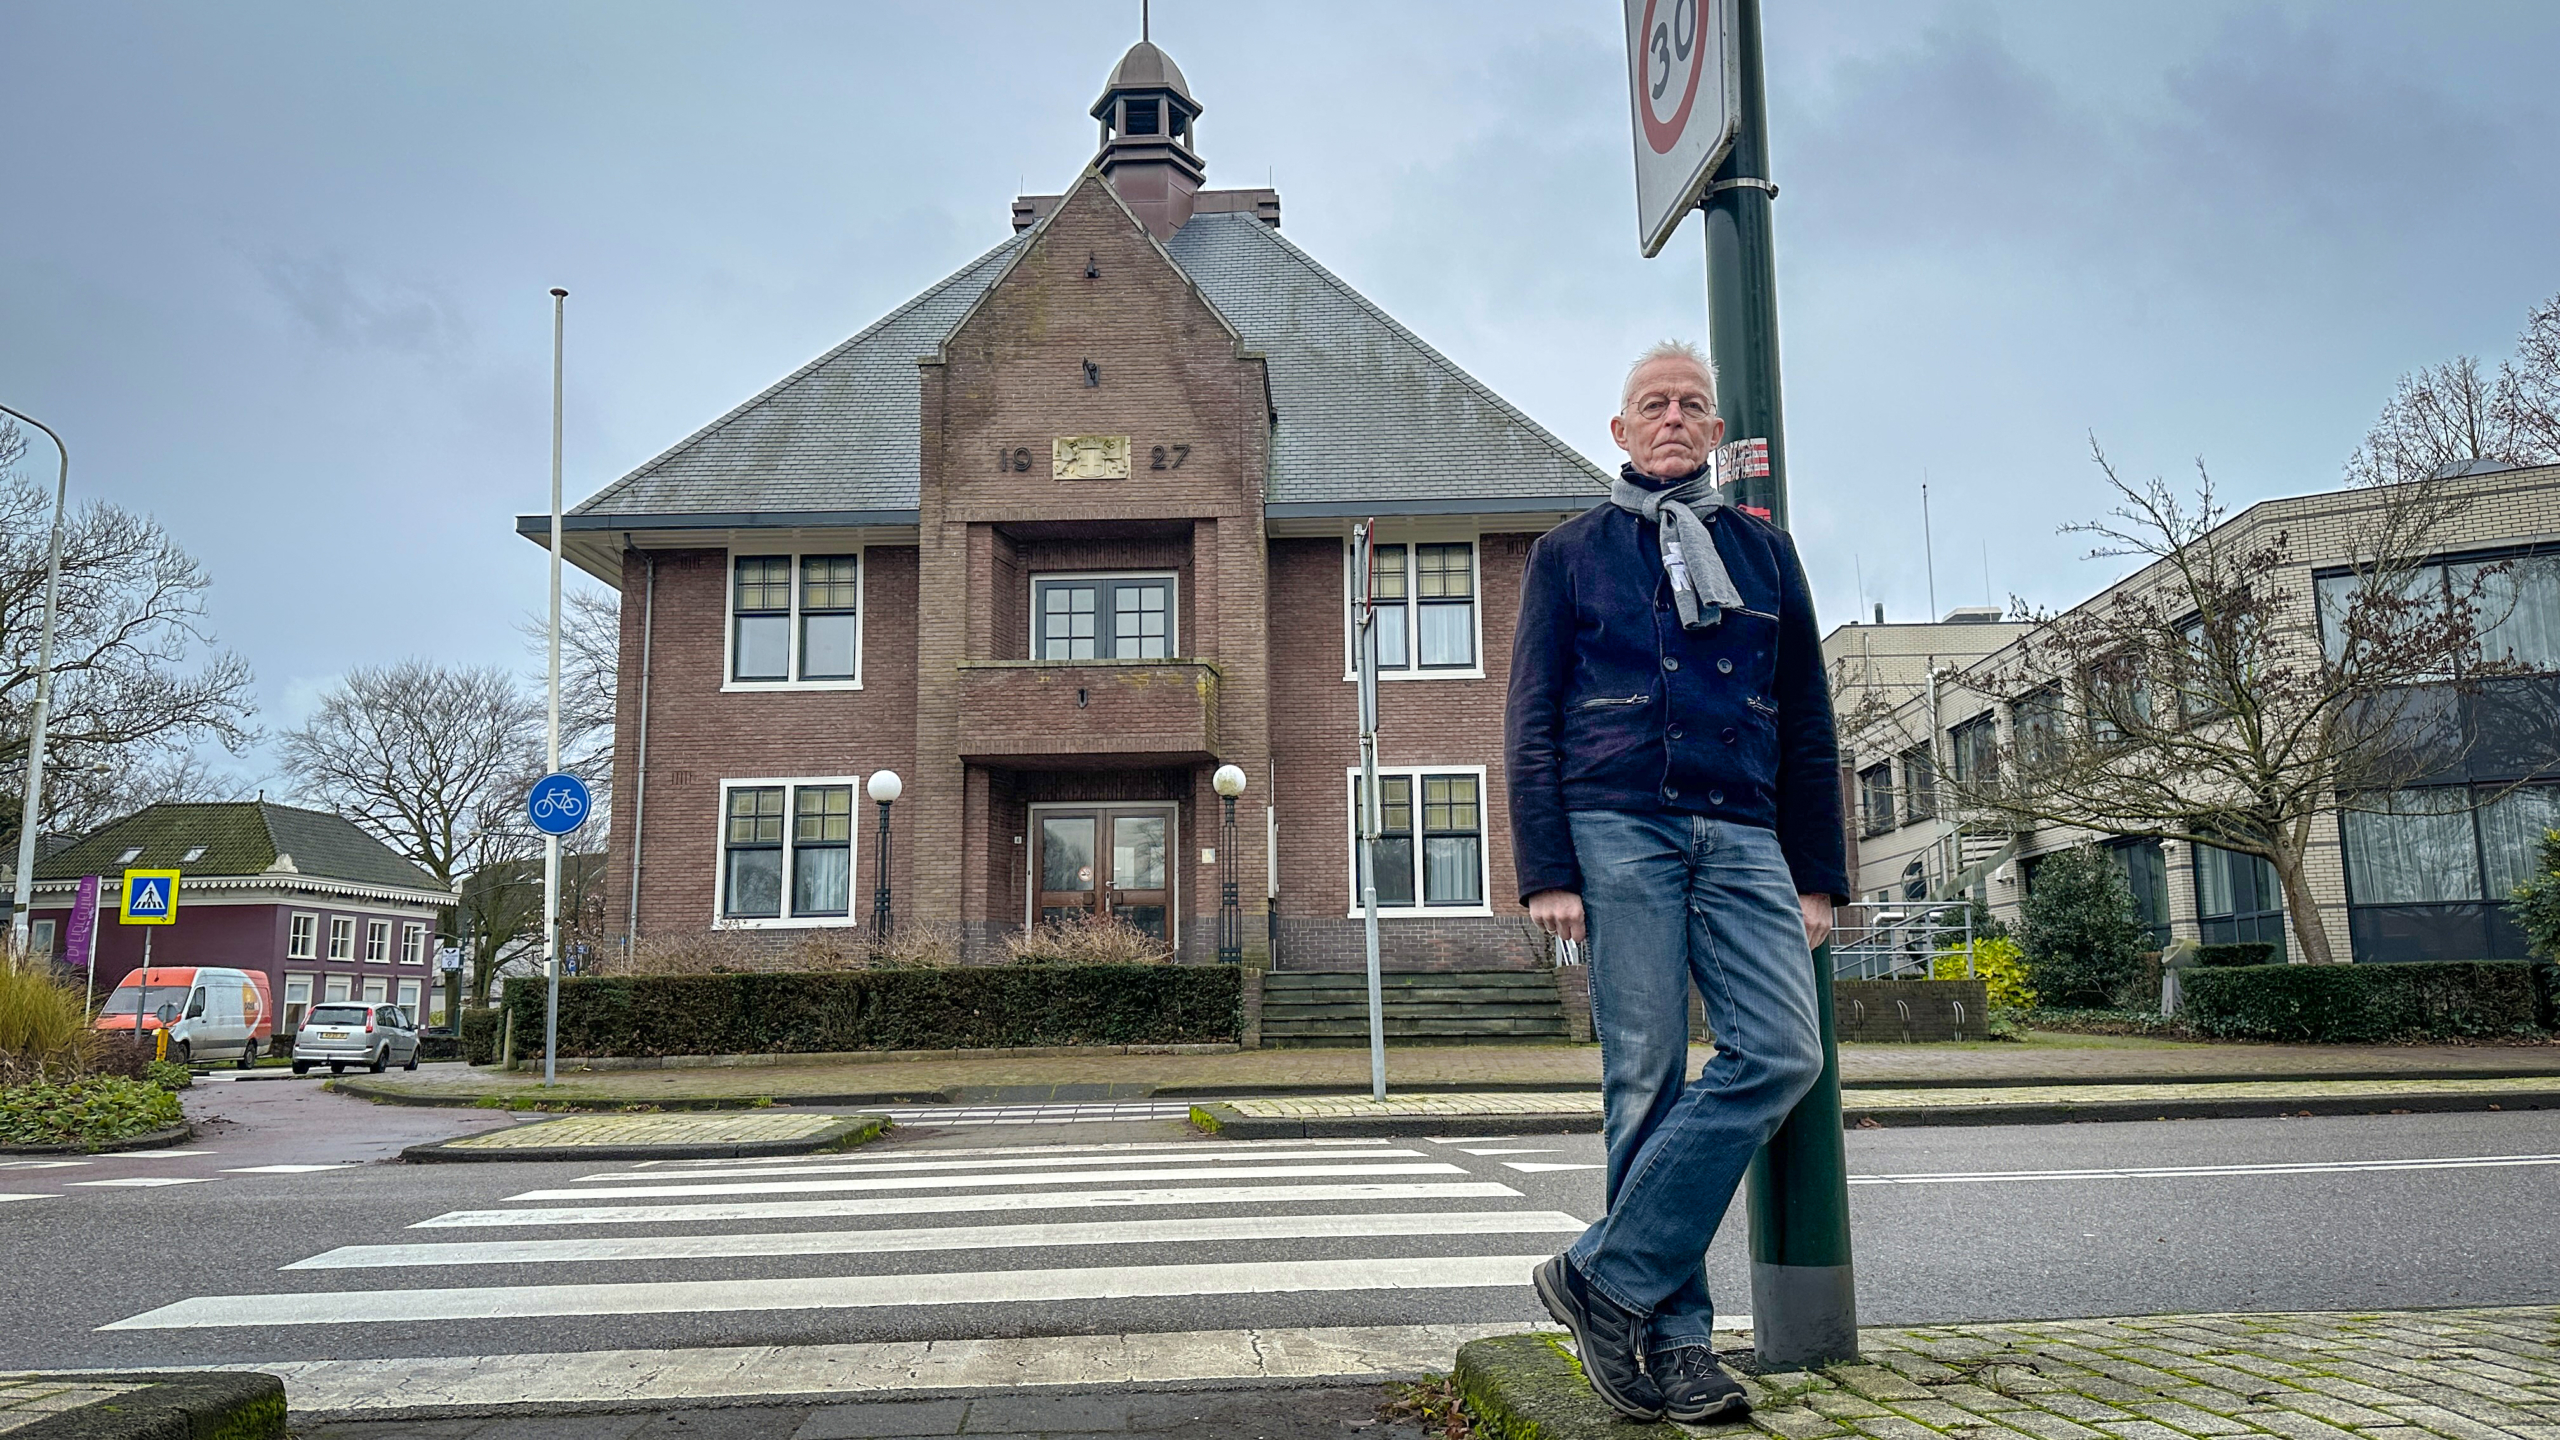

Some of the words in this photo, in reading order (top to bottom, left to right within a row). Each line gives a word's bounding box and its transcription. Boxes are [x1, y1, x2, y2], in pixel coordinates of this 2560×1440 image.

[1650, 0, 1696, 100] 30
[1000, 446, 1033, 472] 19
[1151, 444, 1191, 470] 27
